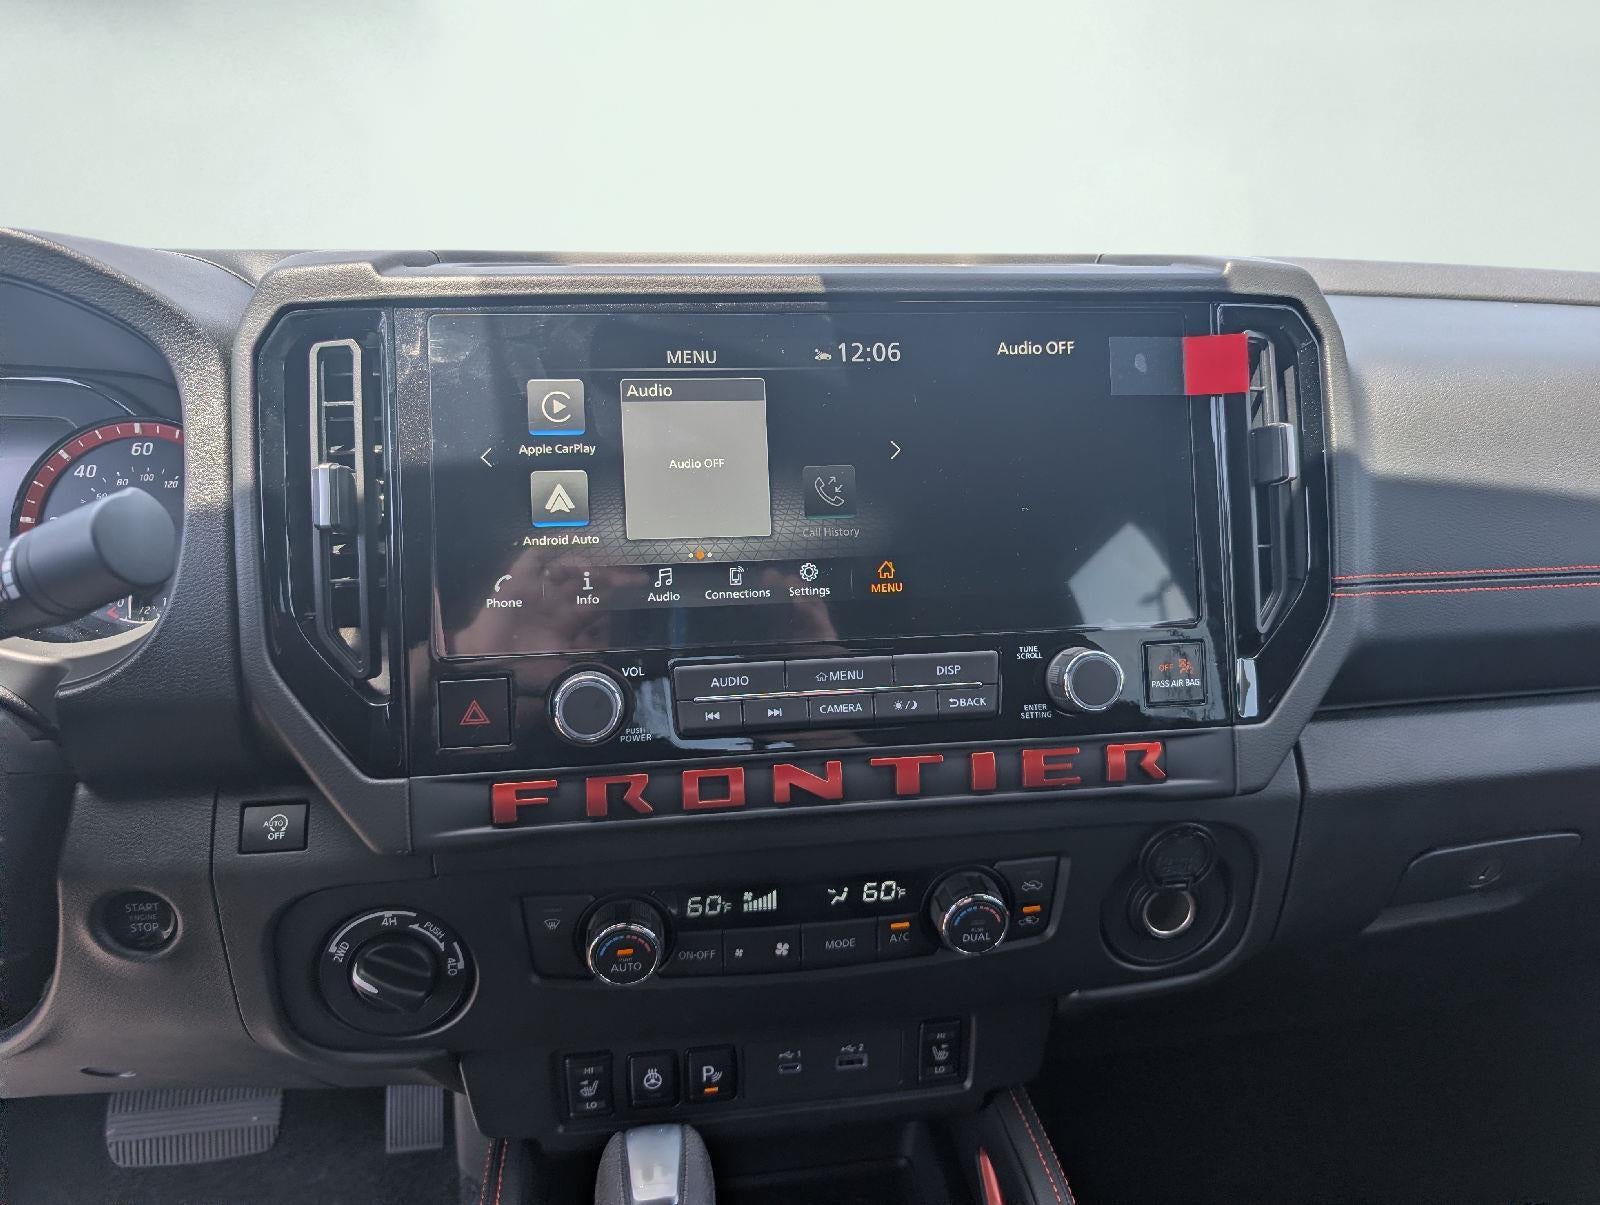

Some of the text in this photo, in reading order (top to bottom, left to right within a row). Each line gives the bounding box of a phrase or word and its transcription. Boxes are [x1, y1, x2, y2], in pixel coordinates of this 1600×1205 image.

[837, 342, 902, 363] 12:06
[997, 340, 1076, 357] Audio OFF
[666, 350, 718, 365] MENU
[626, 383, 673, 398] Audio
[131, 442, 154, 456] 60
[518, 443, 596, 457] Apple CarPlay
[669, 458, 725, 470] Audio OFF
[74, 464, 97, 478] 40
[802, 526, 860, 539] Call History
[522, 534, 600, 546] Android Auto
[705, 587, 771, 600] Connections
[789, 584, 830, 598] Settings
[871, 582, 903, 594] MENU
[486, 597, 523, 609] Phone
[576, 594, 600, 606] Info
[647, 591, 681, 603] Audio
[1018, 645, 1039, 653] TUNE
[1016, 651, 1043, 660] SCROLL
[622, 667, 645, 677] VOL
[829, 670, 864, 682] MENU
[936, 664, 961, 676] DISP
[710, 676, 750, 688] AUDIO
[1151, 678, 1200, 688] PASS AIR BAG
[959, 697, 987, 708] BACK
[1023, 704, 1048, 713] ENTER
[819, 703, 863, 715] CAMERA
[1020, 710, 1053, 720] SETTING
[625, 728, 646, 736] PUSH
[620, 734, 652, 743] POWER
[491, 740, 1167, 824] FRONTIER
[267, 832, 286, 841] OFF
[124, 902, 160, 914] START
[130, 921, 160, 934] STOP
[381, 917, 398, 927] 4H
[423, 921, 446, 940] PUSH
[889, 932, 910, 943] A/C
[961, 932, 991, 943] DUAL
[824, 938, 856, 950] MODE
[333, 940, 351, 963] 2WD
[446, 955, 458, 977] 4LO
[610, 961, 642, 974] AUTO
